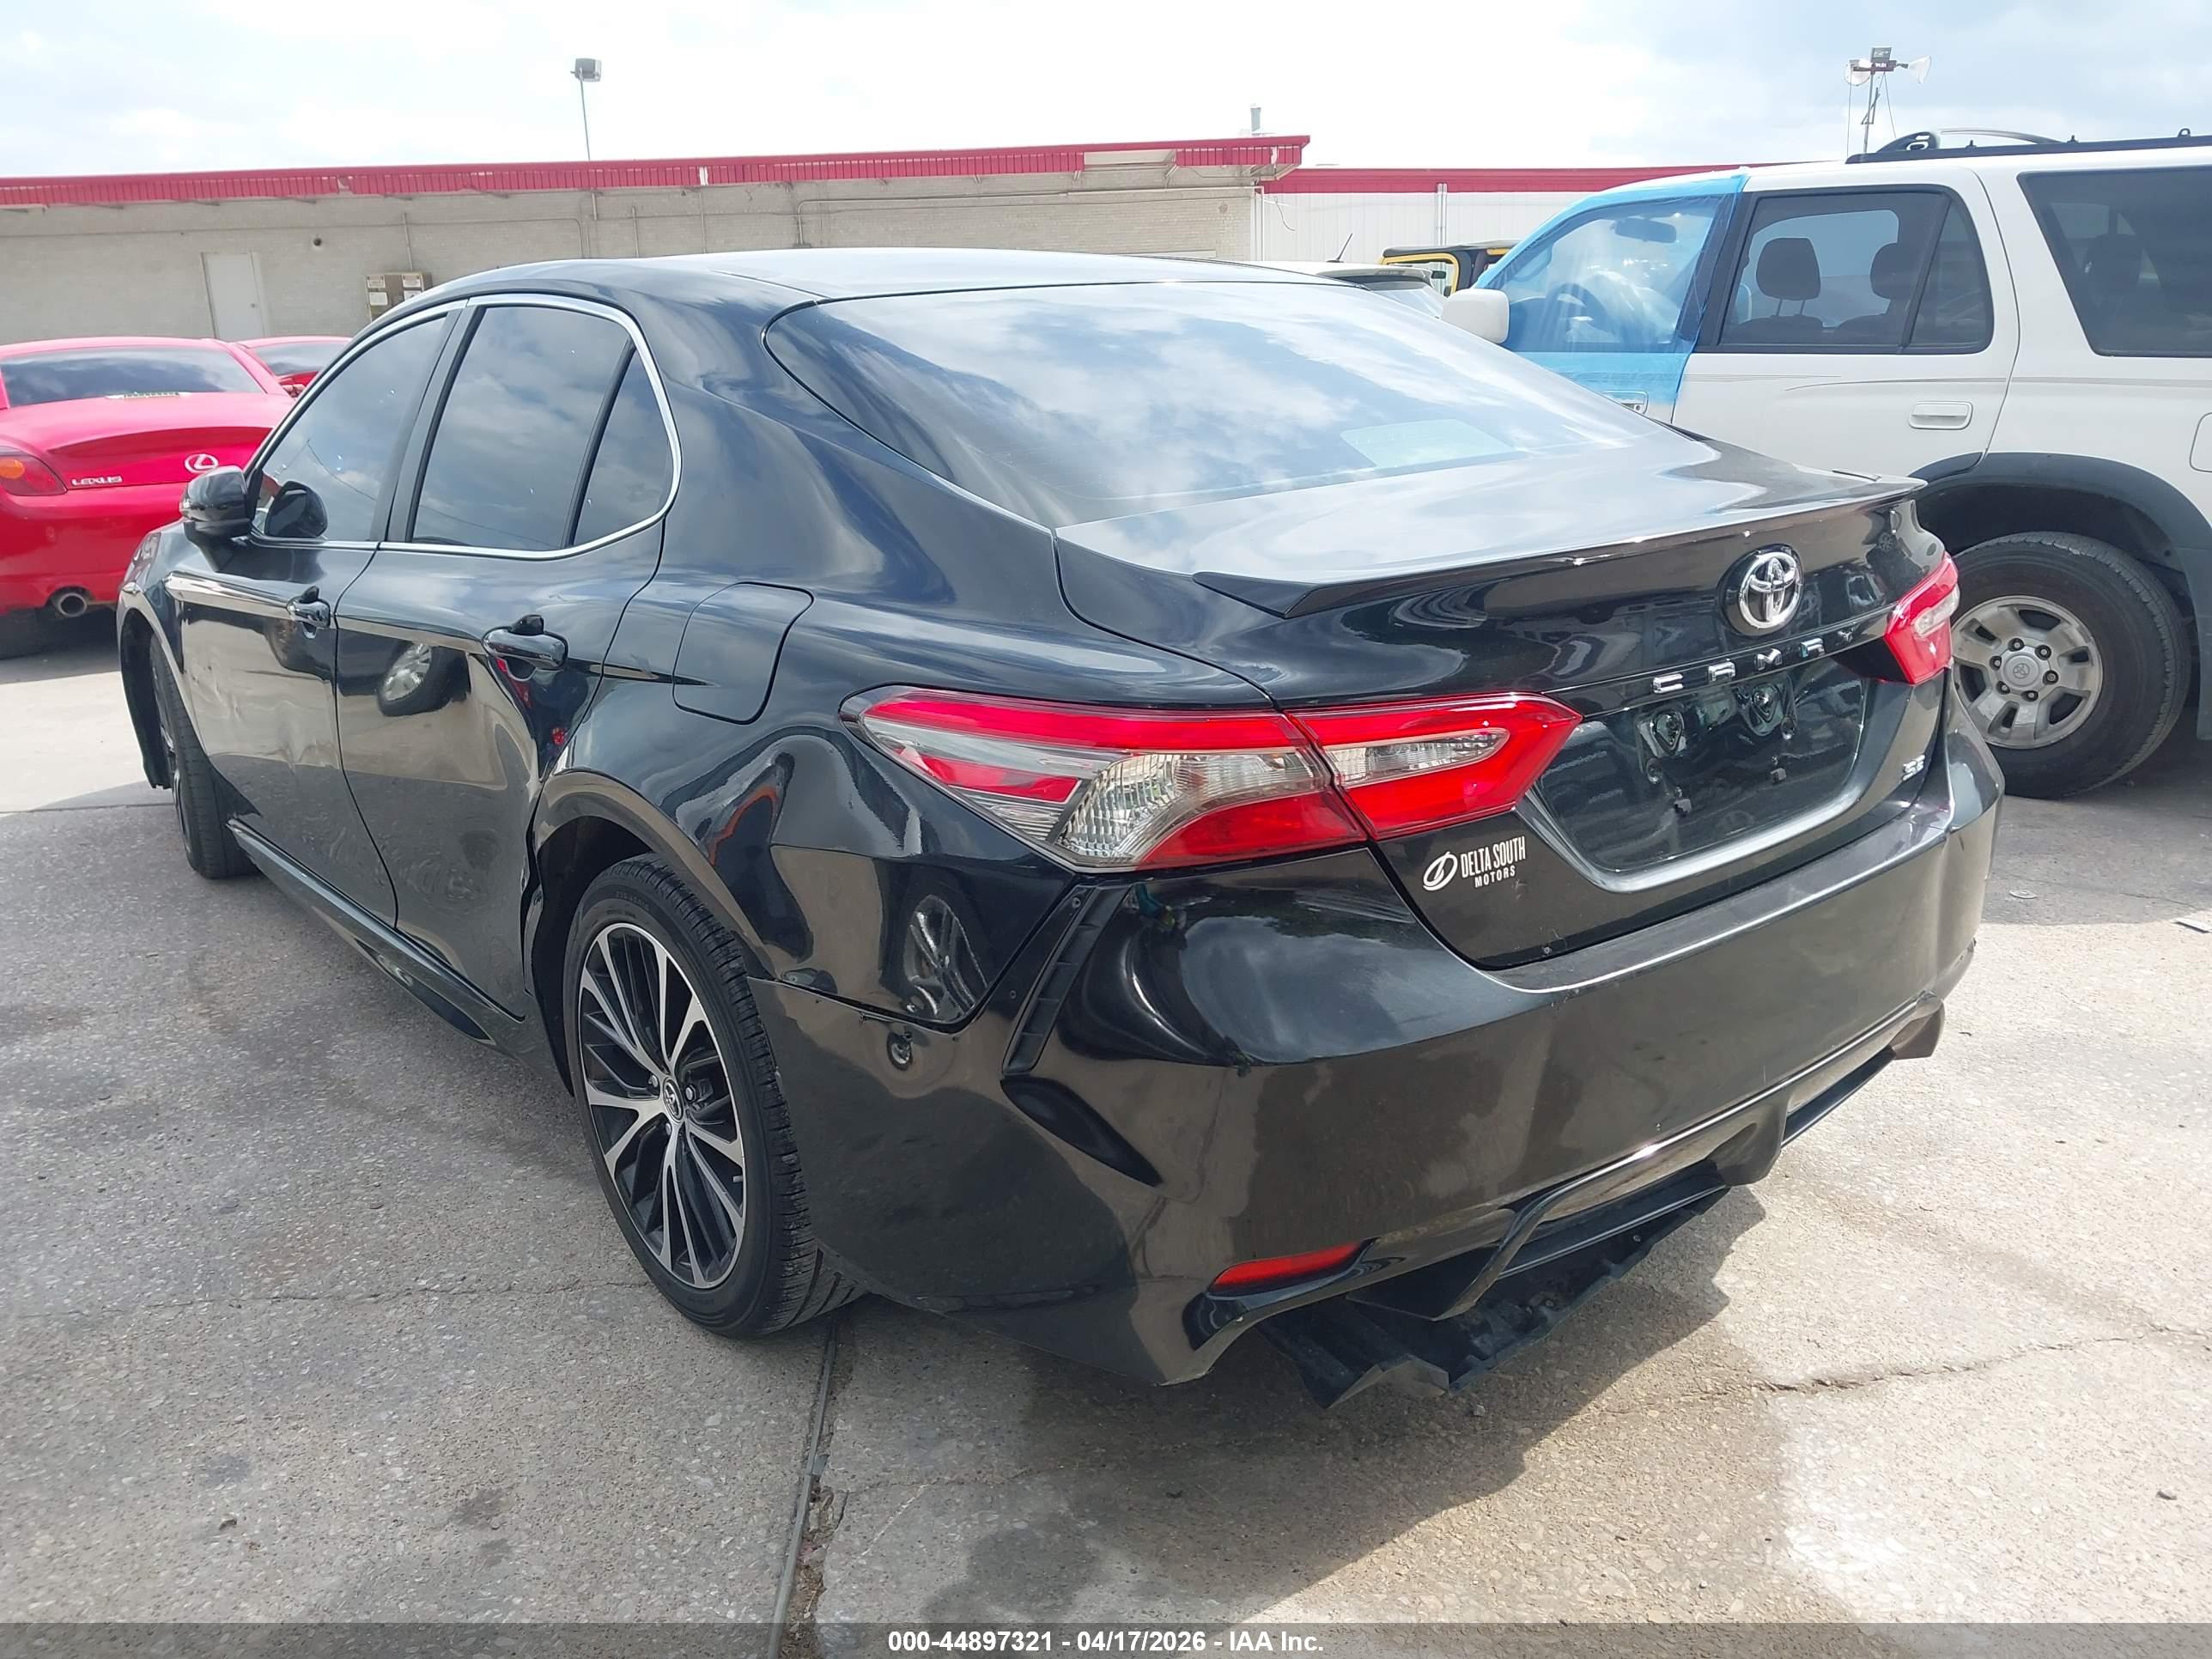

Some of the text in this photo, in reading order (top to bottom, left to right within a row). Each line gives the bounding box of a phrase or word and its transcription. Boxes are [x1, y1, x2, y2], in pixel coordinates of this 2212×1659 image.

[71, 475, 123, 486] LEXUS
[1652, 629, 1855, 694] CAMRY
[1902, 755, 1926, 781] SE
[1460, 836, 1526, 878] DELTA SOUTH
[1474, 866, 1516, 888] MOTORS
